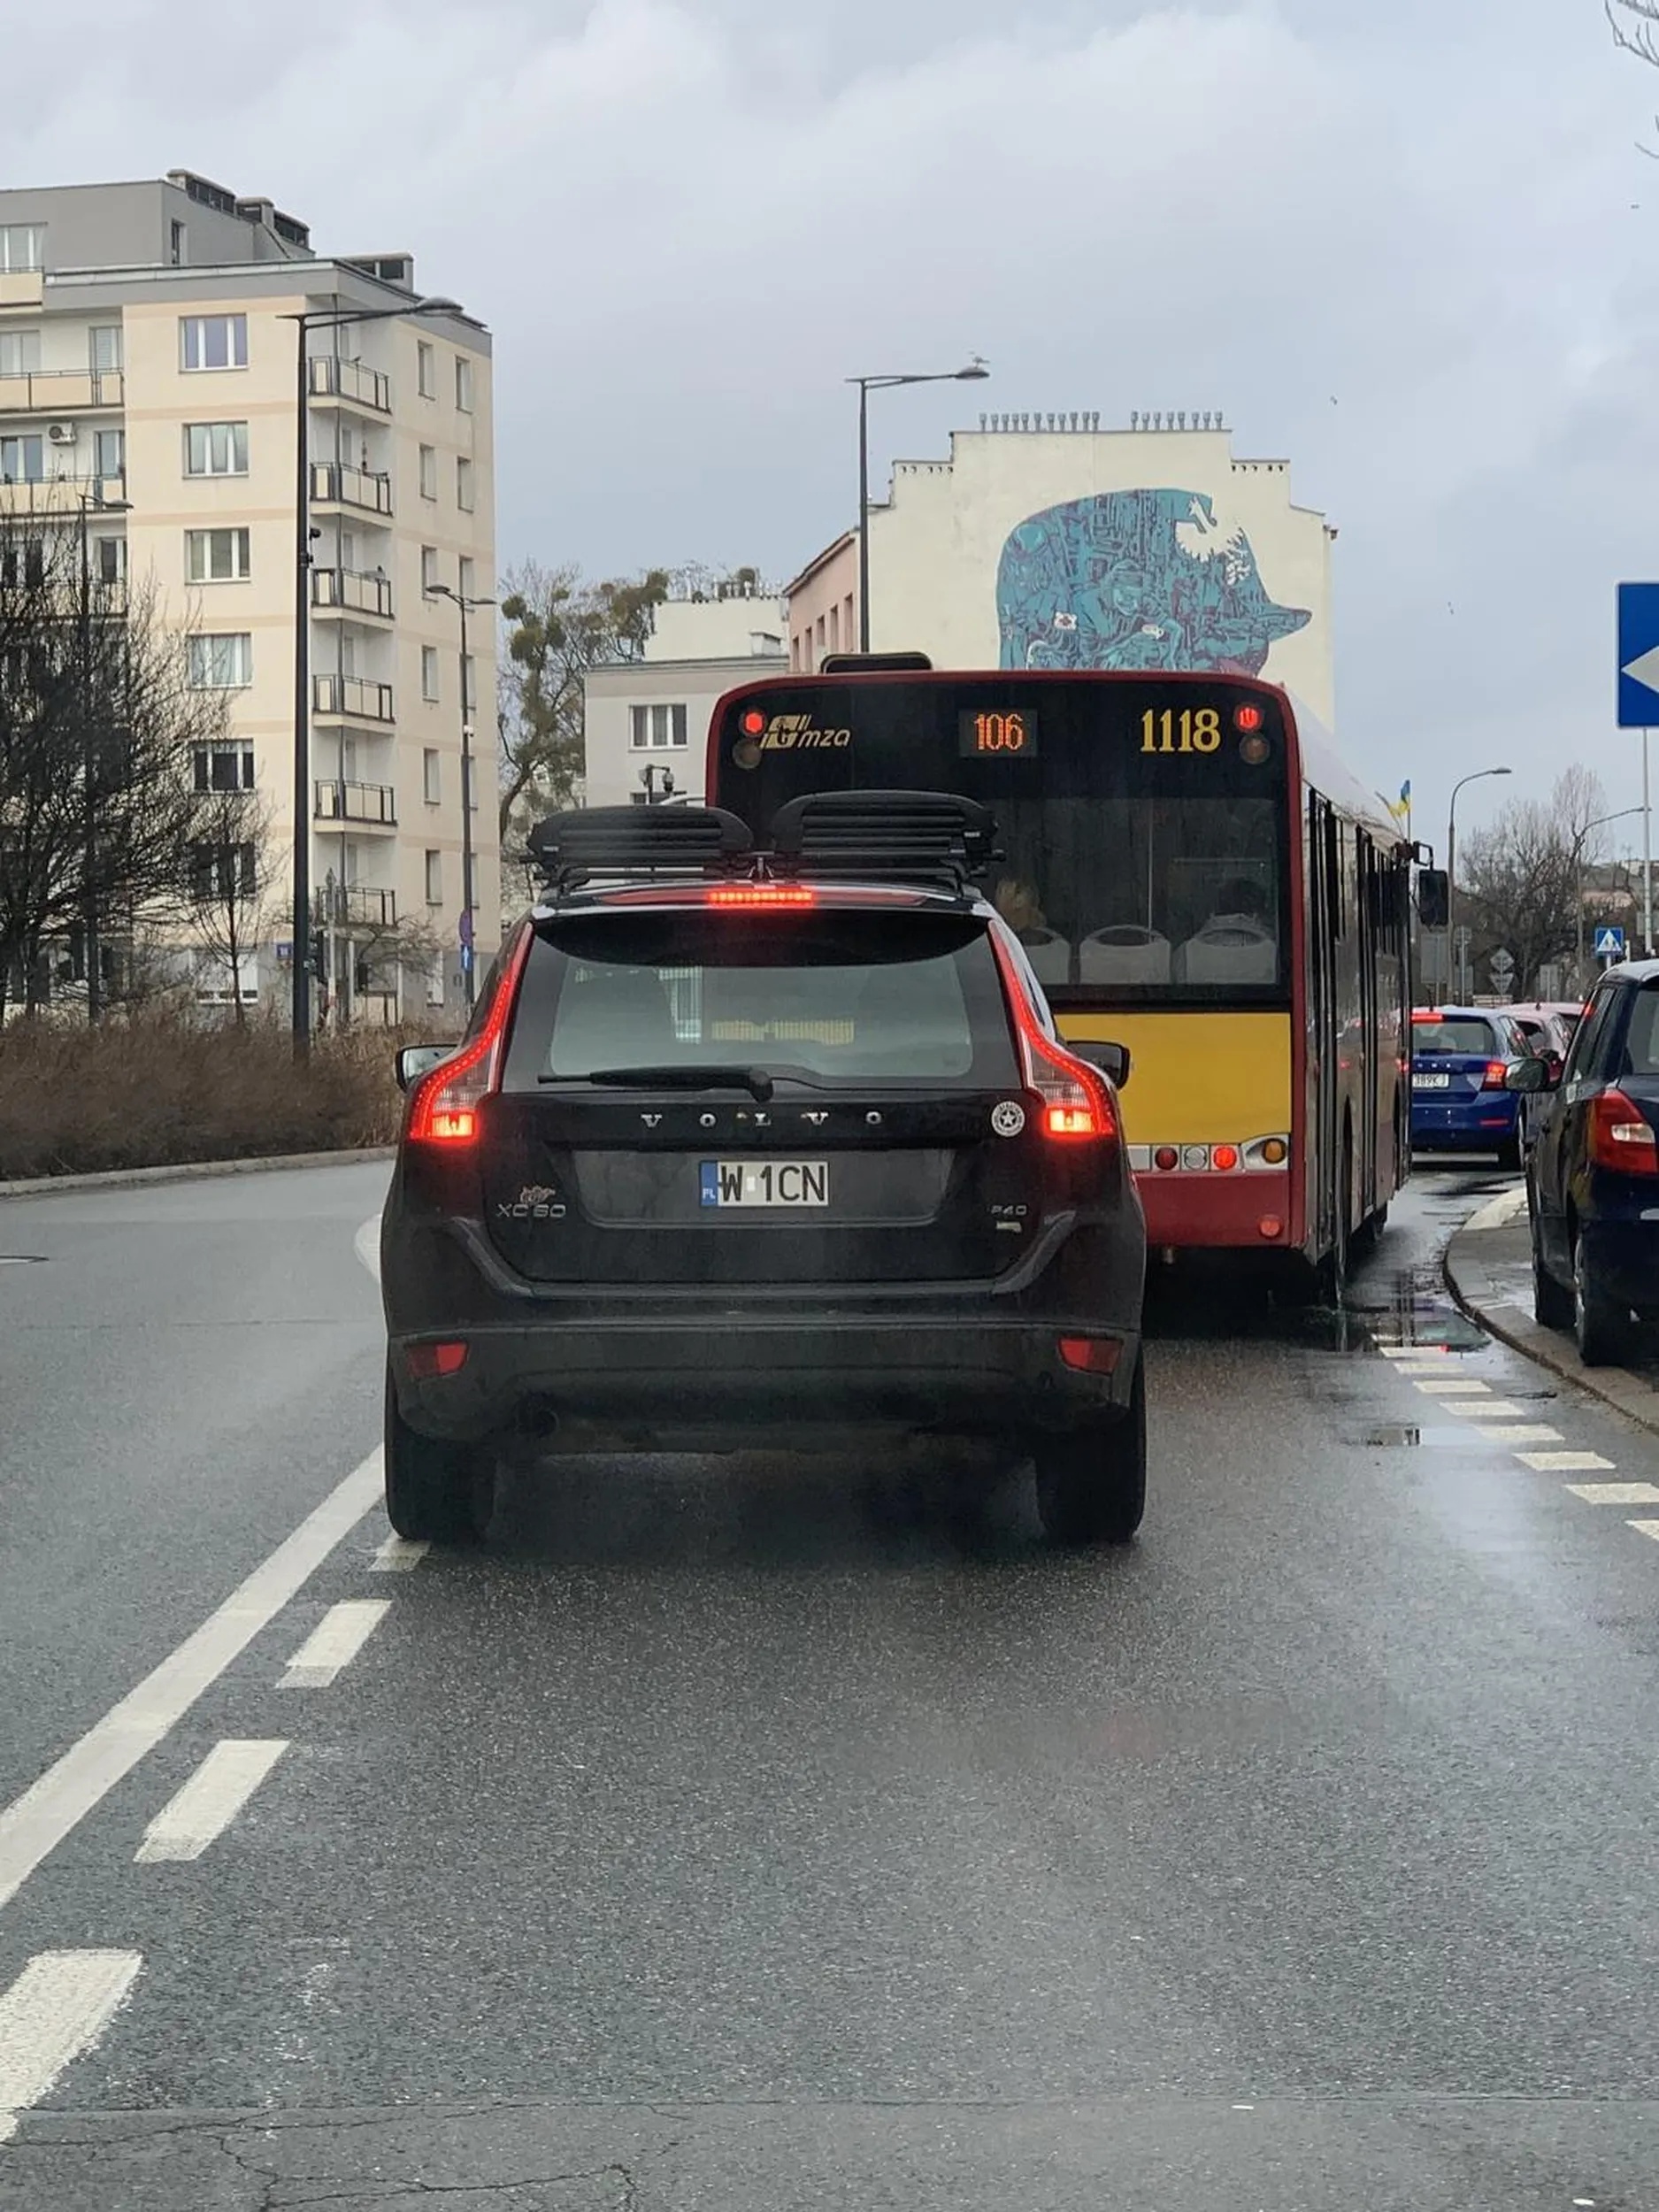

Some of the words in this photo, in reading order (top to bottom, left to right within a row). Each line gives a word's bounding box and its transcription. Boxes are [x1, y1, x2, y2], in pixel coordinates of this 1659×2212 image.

[974, 713, 1023, 750] 106
[1141, 709, 1221, 752] 1118
[641, 1111, 882, 1127] VOLVO
